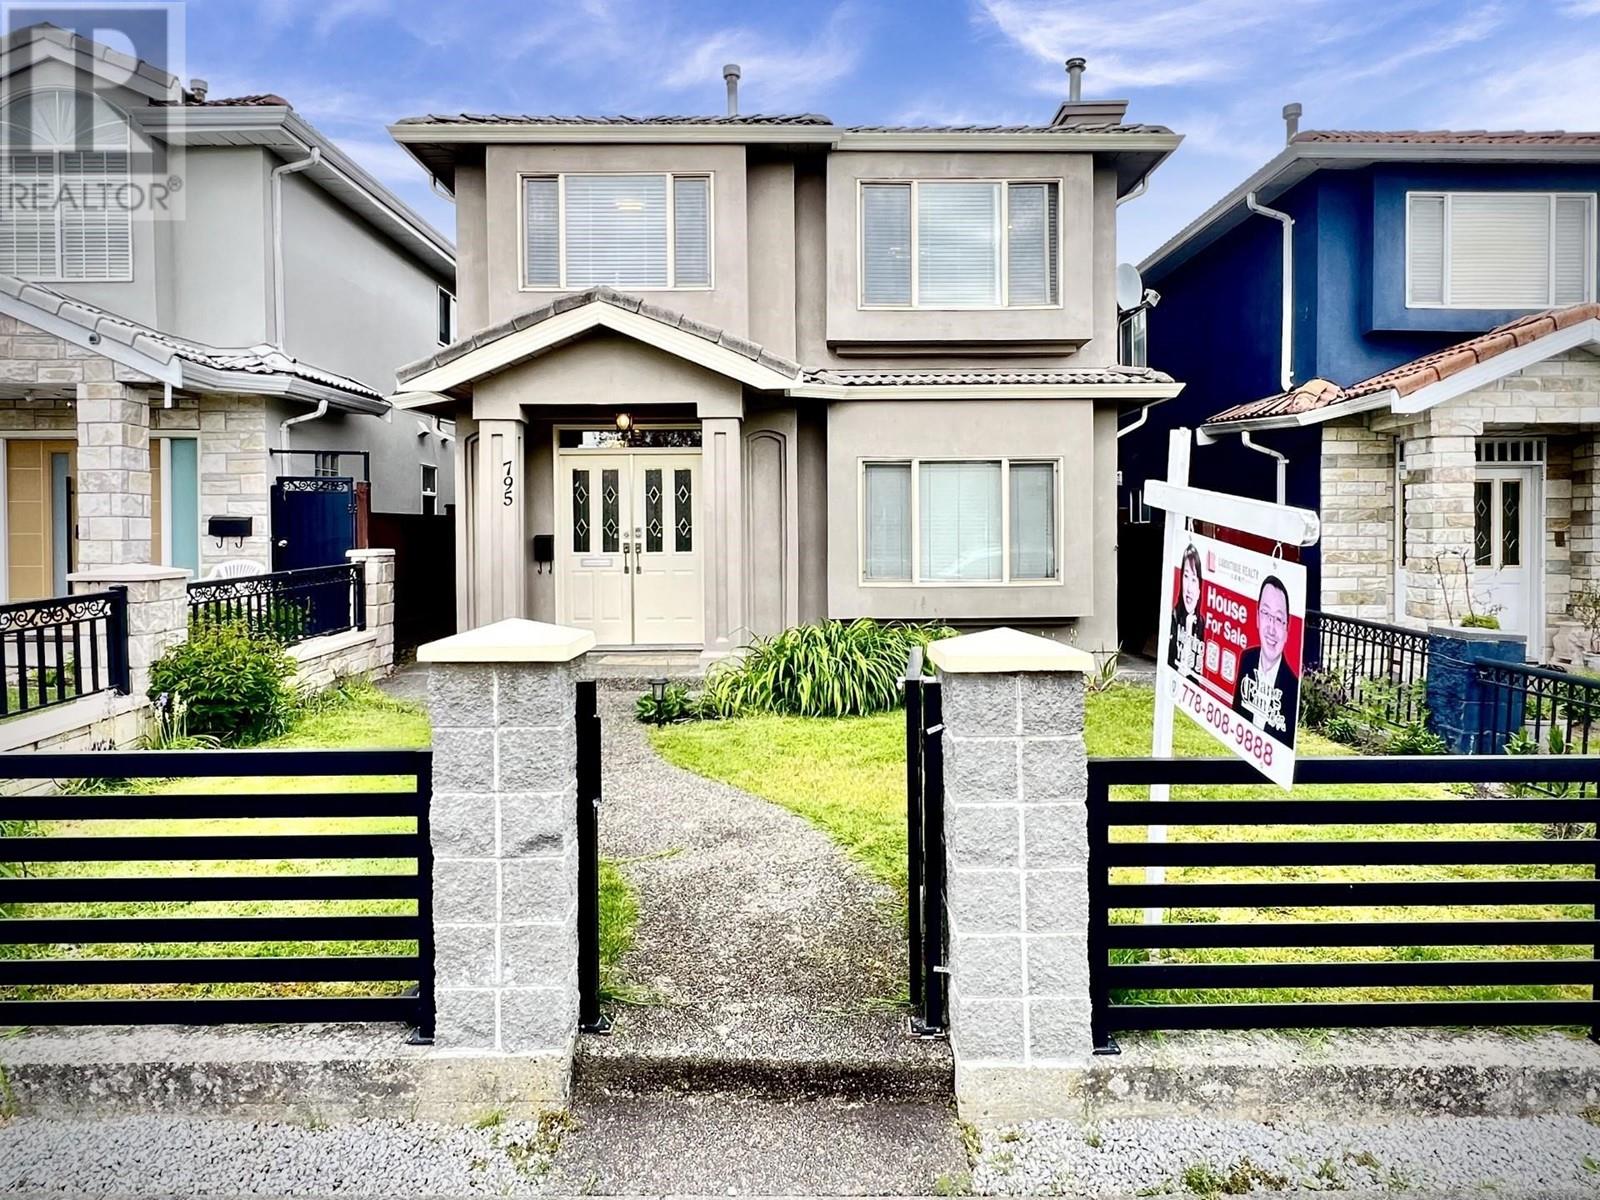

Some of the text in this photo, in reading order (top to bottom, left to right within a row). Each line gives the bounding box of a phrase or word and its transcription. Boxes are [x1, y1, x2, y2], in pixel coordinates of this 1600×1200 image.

[502, 460, 514, 507] 795
[1207, 585, 1248, 624] House
[1205, 611, 1223, 635] For
[1223, 621, 1248, 649] Sale
[1182, 683, 1273, 766] 778-808-9888
